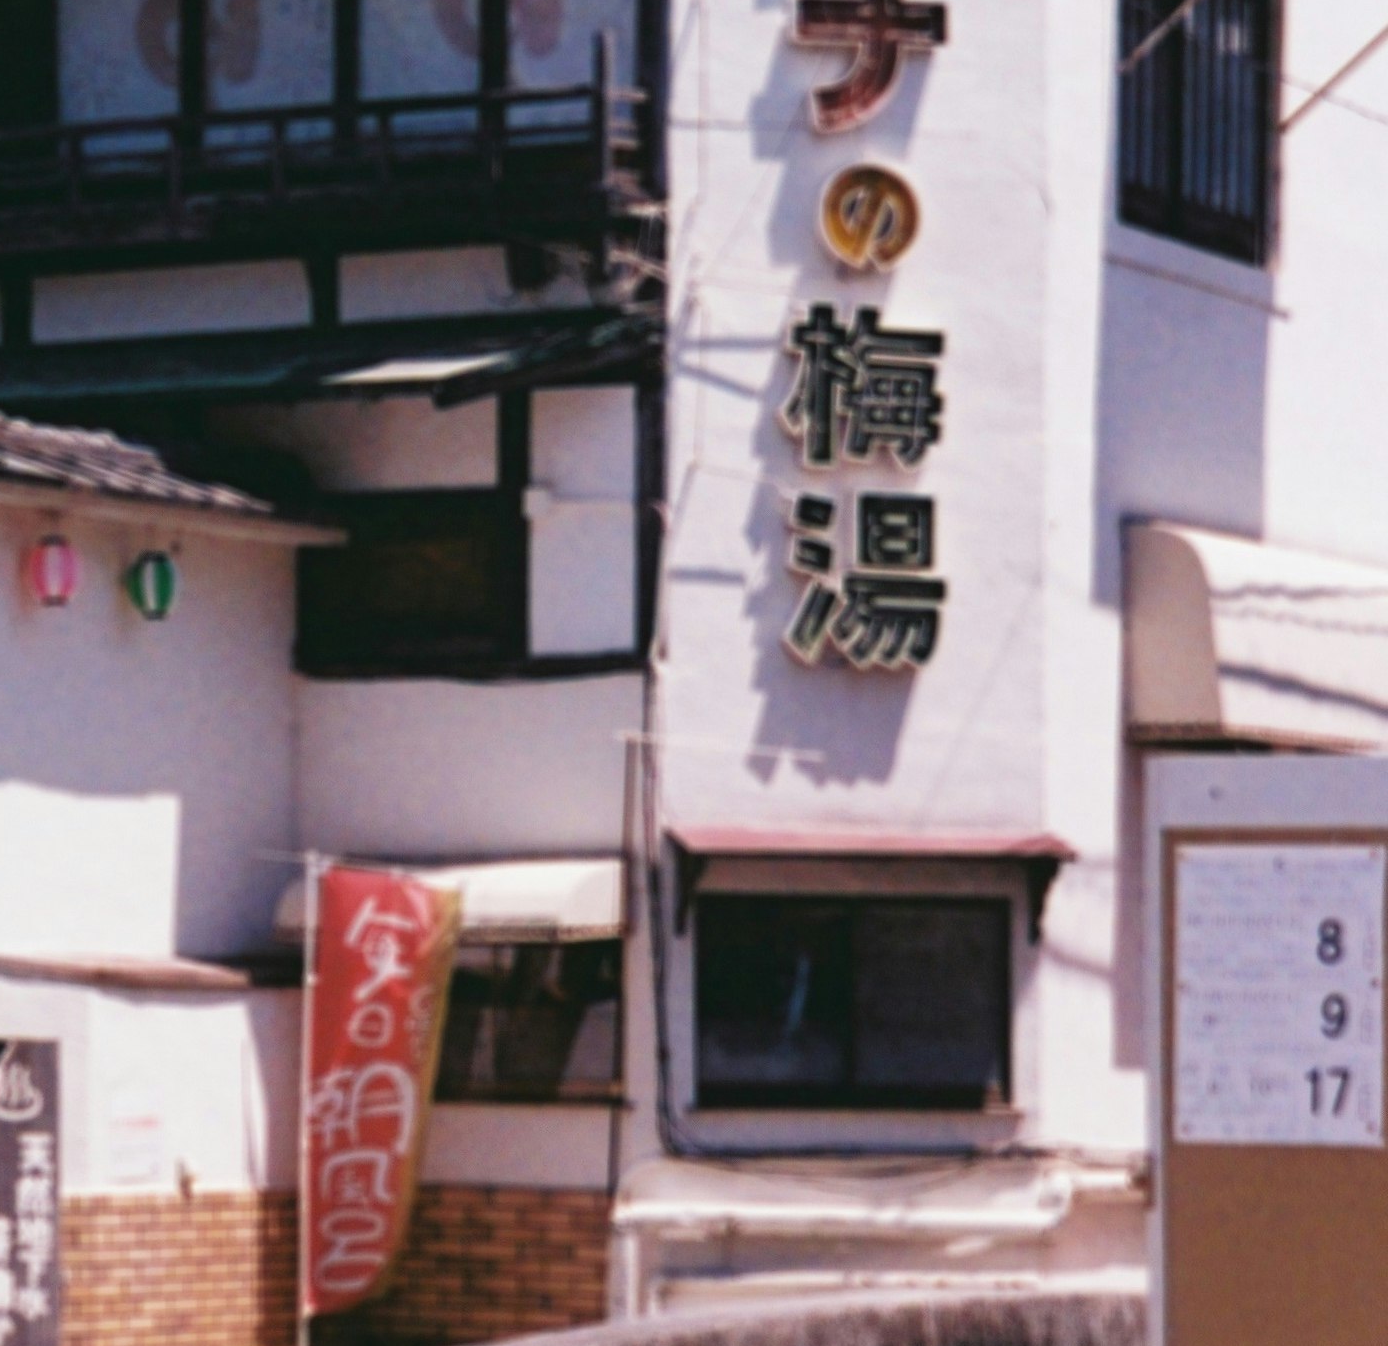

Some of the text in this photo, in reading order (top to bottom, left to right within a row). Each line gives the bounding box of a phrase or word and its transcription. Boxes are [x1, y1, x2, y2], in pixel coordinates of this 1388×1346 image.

[1316, 917, 1343, 965] 8
[1320, 993, 1348, 1039] 9
[1305, 1065, 1351, 1118] 17
